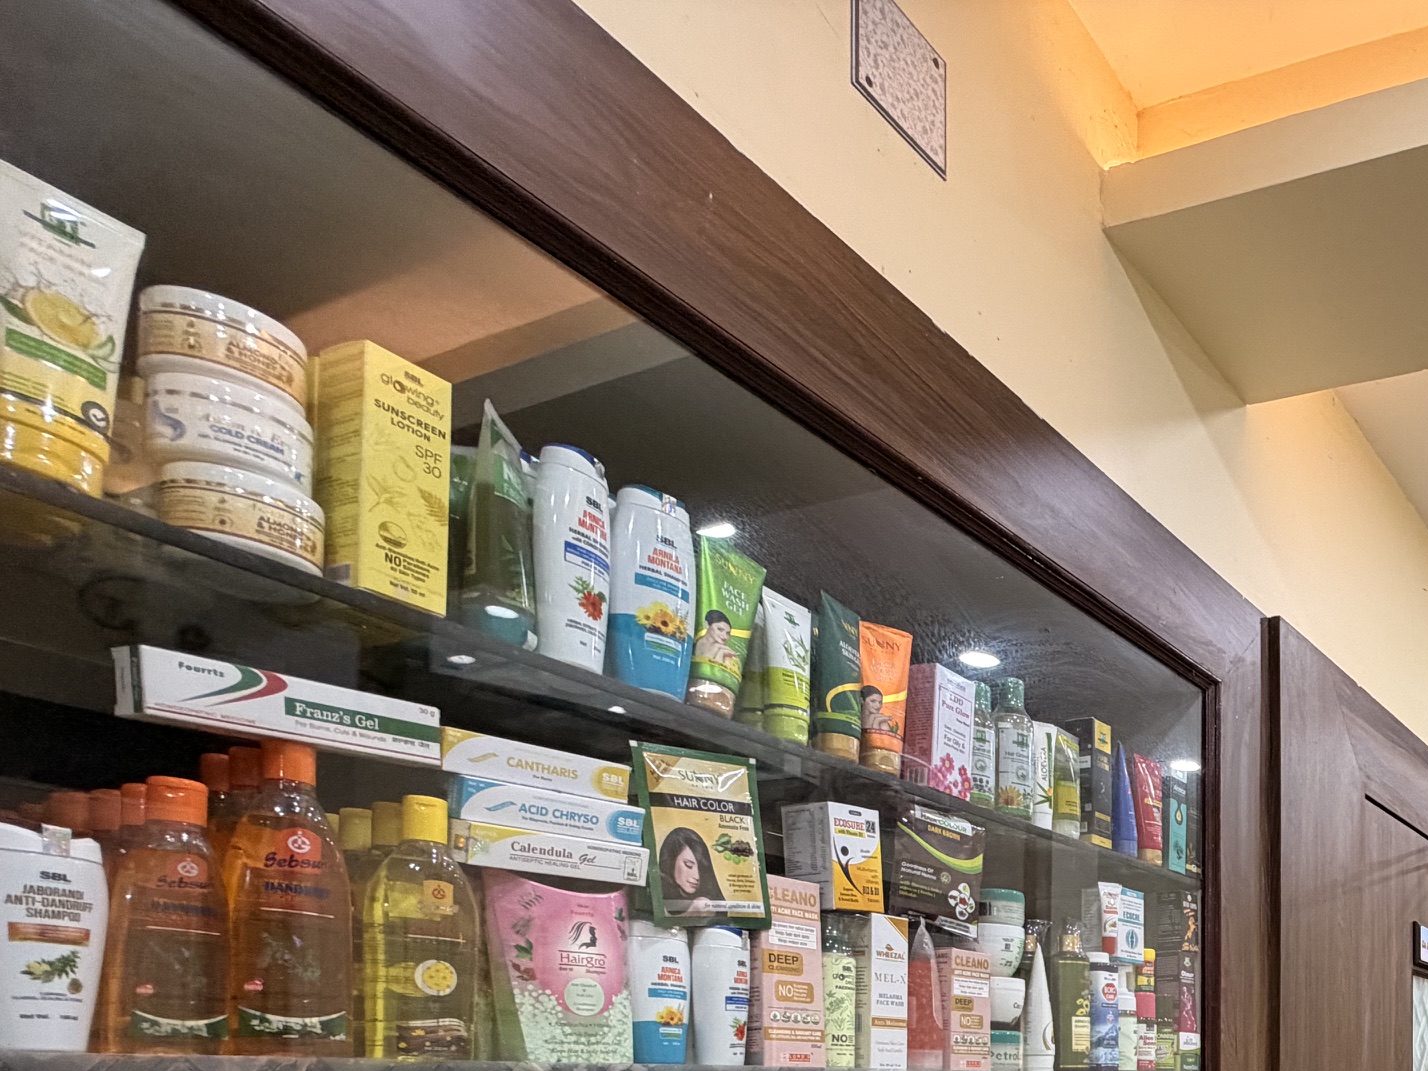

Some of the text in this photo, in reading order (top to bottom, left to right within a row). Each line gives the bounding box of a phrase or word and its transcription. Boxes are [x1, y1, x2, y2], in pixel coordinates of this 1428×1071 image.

[380, 373, 435, 408] glowing
[407, 395, 445, 421] beauty
[374, 398, 447, 440] SUNSCREEN
[390, 417, 431, 442] LOTION
[209, 424, 245, 441] COLD
[246, 432, 285, 456] CREAM
[415, 444, 443, 465] SPF
[422, 461, 442, 479] 30
[586, 495, 604, 513] SBL
[656, 535, 677, 549] SBL
[384, 552, 402, 567] NO
[647, 554, 683, 575] MONTANA
[715, 554, 755, 585] SUNNY
[723, 580, 747, 600] FACE
[721, 588, 750, 611] WASH
[725, 601, 744, 616] GEL
[862, 635, 902, 652] SUNNY
[178, 660, 226, 679] Fourrts
[294, 702, 380, 732] Franz's Gel
[506, 756, 579, 781] CANTHARIS
[602, 772, 625, 785] SBL
[674, 796, 735, 813] HAIR COLOR
[518, 803, 549, 817] ACID
[552, 808, 600, 826] CHRYSO
[617, 817, 640, 828] SBL
[719, 815, 745, 825] BLACK
[834, 817, 876, 834] ECOSURE 24
[937, 815, 968, 833] COLOUR
[510, 841, 597, 866] Calendula Gel
[509, 855, 581, 871] ANTISEPTIC HEALING GEL
[901, 861, 925, 872] Goodness
[39, 871, 72, 883] SBL
[901, 867, 920, 877] Natural
[22, 884, 85, 900] JABORANDI
[5, 894, 94, 914] ANTI-DANDRUFF
[25, 907, 82, 923] SHAMPOO
[777, 907, 791, 915] ACNE
[791, 909, 804, 918] FACE
[559, 952, 606, 968] Hairgro
[662, 955, 679, 964] SBL
[768, 953, 799, 966] DEEP
[875, 950, 905, 961] WHEEZAL
[954, 955, 989, 971] CLEANO
[661, 966, 681, 975] ARNICA
[842, 965, 853, 973] SBL
[657, 973, 684, 983] MONTANA
[874, 972, 907, 985] MEL-X
[778, 984, 794, 997] NO
[954, 997, 973, 1006] DEEP
[960, 1016, 971, 1026] NO
[831, 1034, 848, 1043] NO
